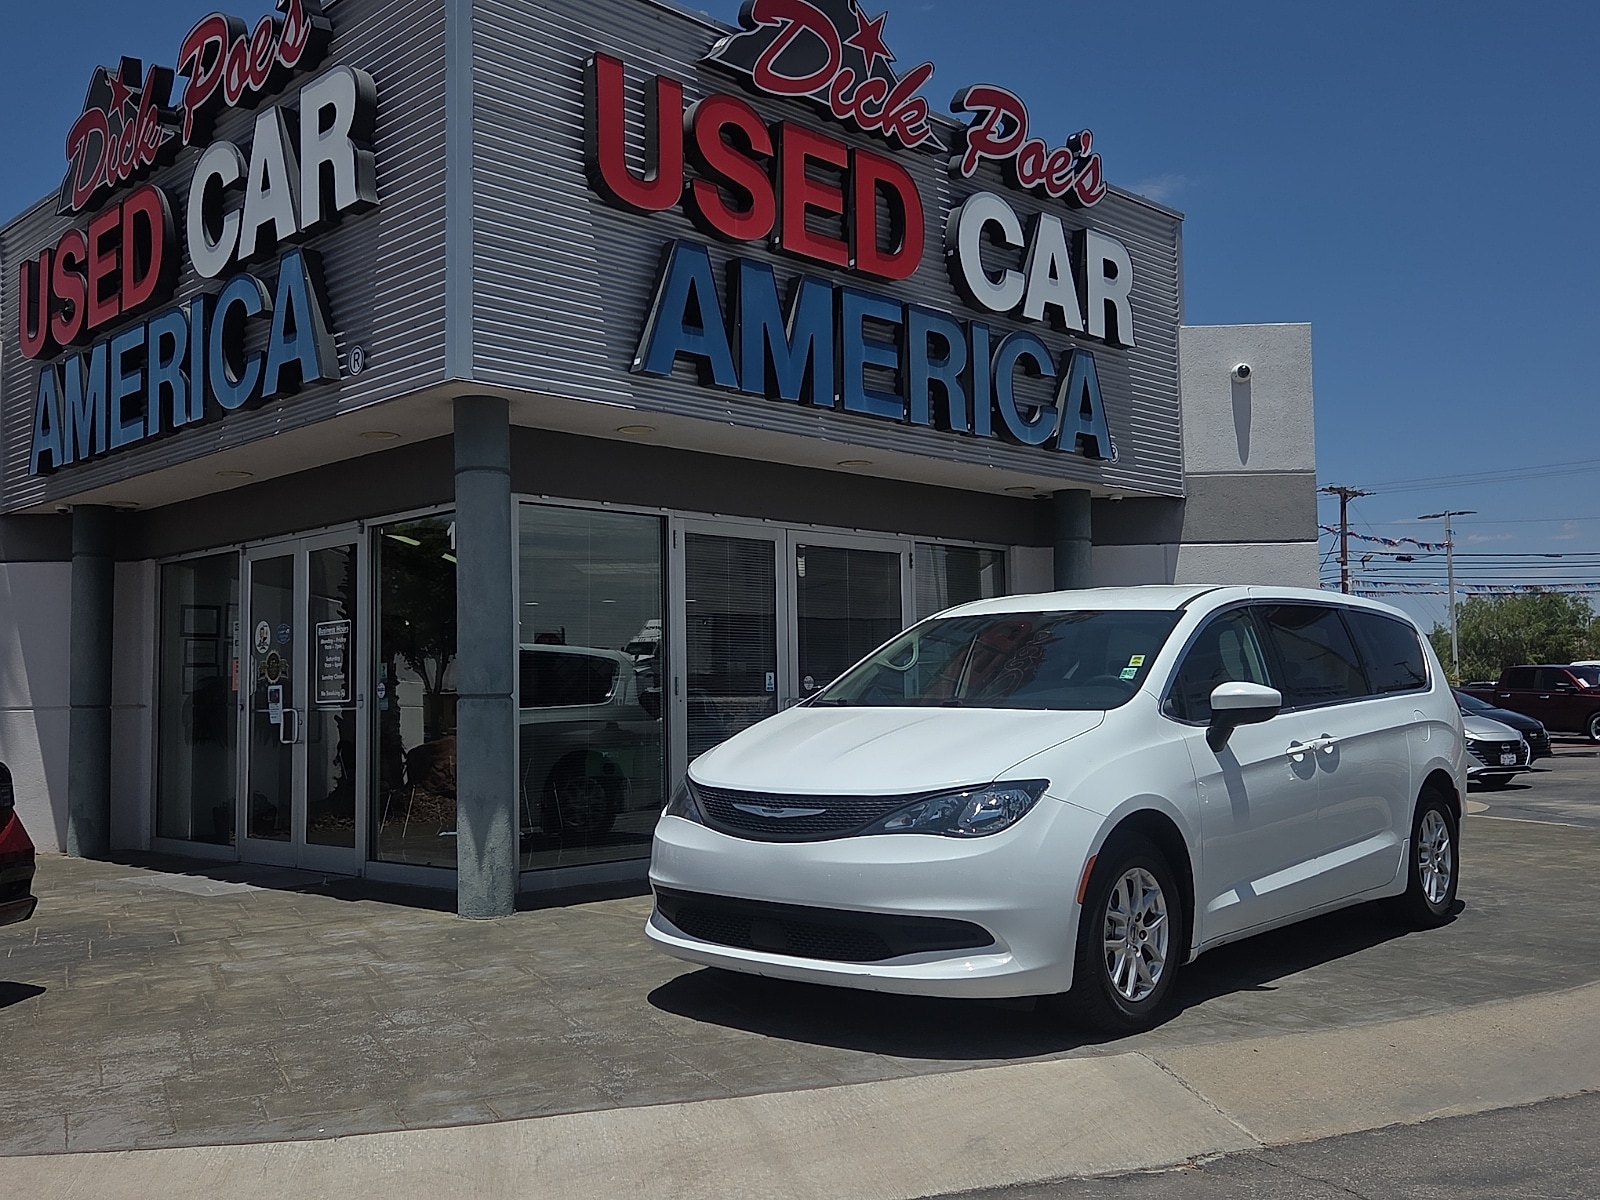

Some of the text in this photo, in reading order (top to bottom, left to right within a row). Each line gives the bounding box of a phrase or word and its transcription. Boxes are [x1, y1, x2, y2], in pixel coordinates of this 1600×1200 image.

[19, 66, 361, 359] USED CAR
[66, 0, 311, 211] Dick Poes
[590, 51, 1136, 348] USED CAR
[752, 0, 1108, 208] Dick Poe's
[29, 248, 322, 476] AMERICA
[643, 240, 1114, 460] AMERICA
